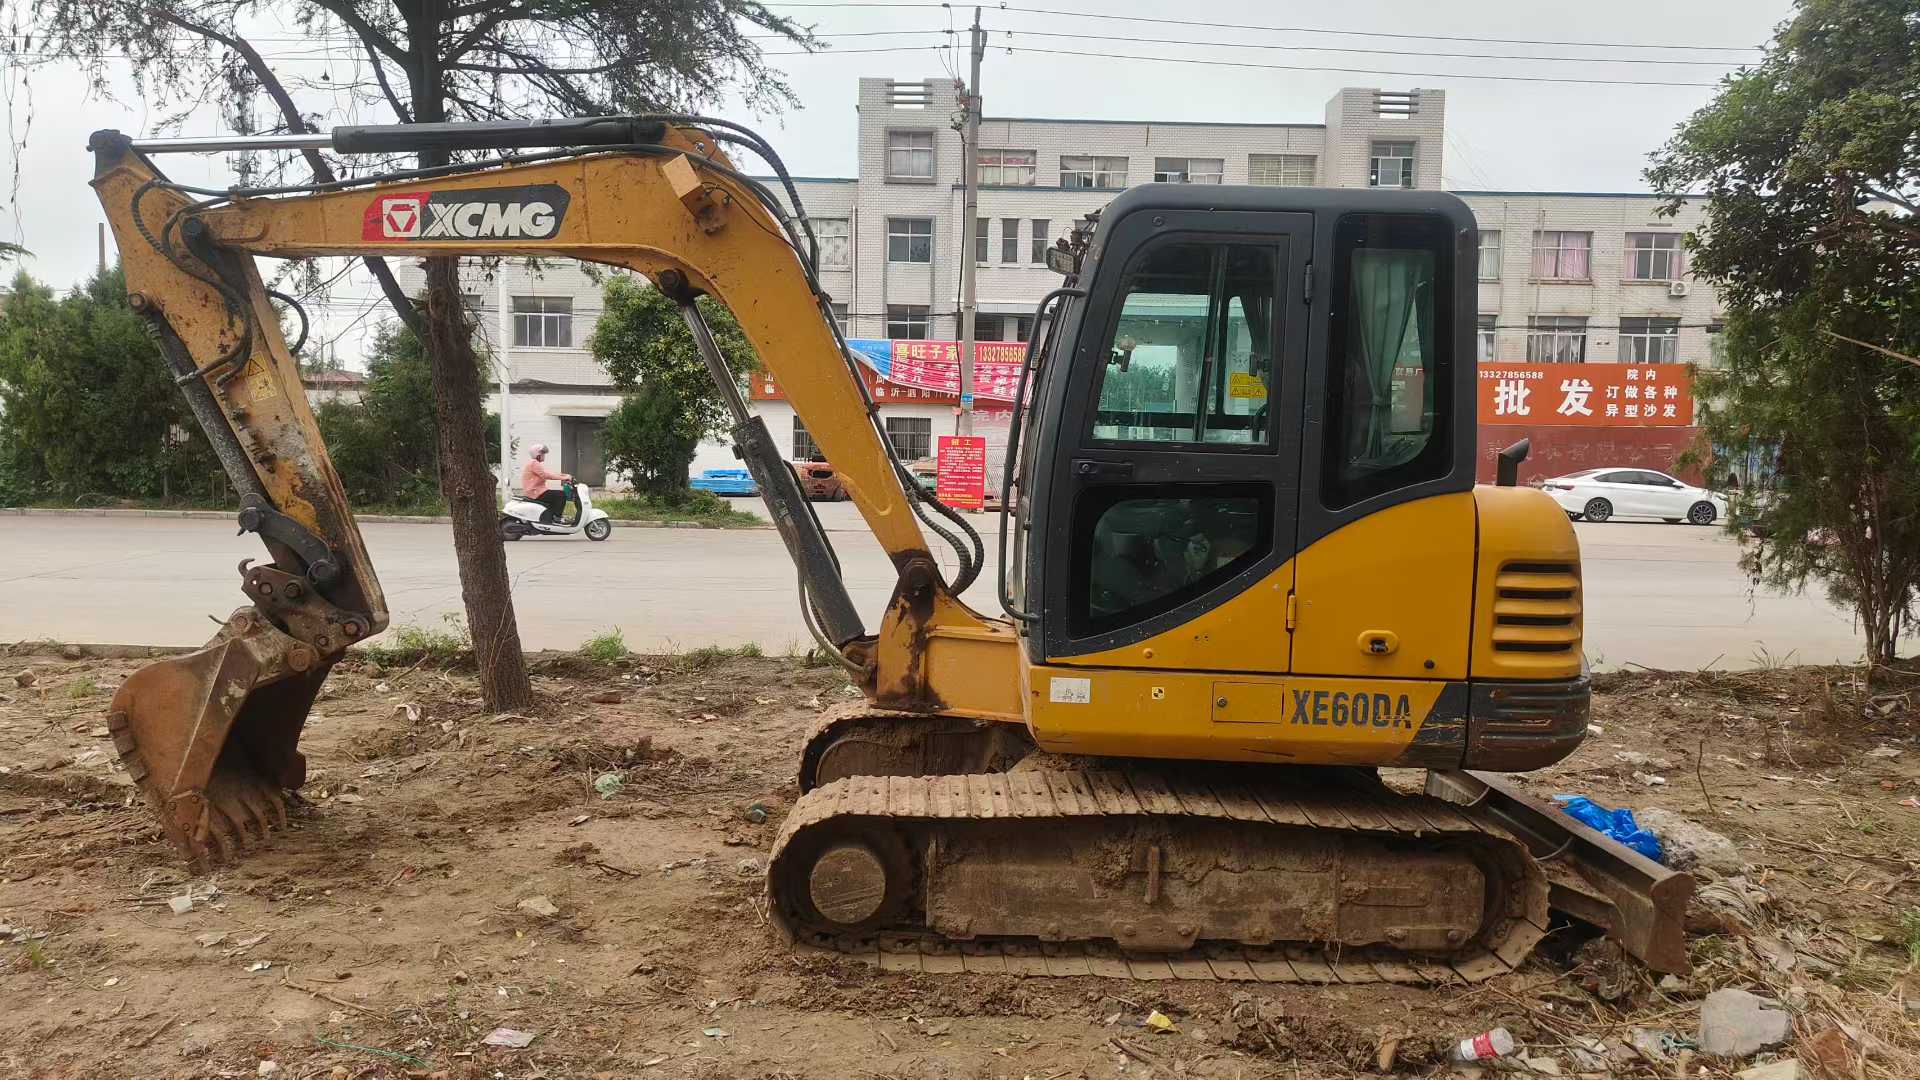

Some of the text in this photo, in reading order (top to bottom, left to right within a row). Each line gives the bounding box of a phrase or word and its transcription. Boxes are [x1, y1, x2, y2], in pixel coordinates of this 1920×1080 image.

[421, 202, 556, 238] XCMG
[895, 344, 976, 361] 喜旺子家
[1480, 370, 1544, 379] 13327856588
[1626, 368, 1656, 380] 院内
[1494, 379, 1593, 416] 批发
[1606, 385, 1678, 399] 订做各种
[1605, 403, 1677, 418] 异型沙发
[1291, 689, 1412, 729] XE60DA
